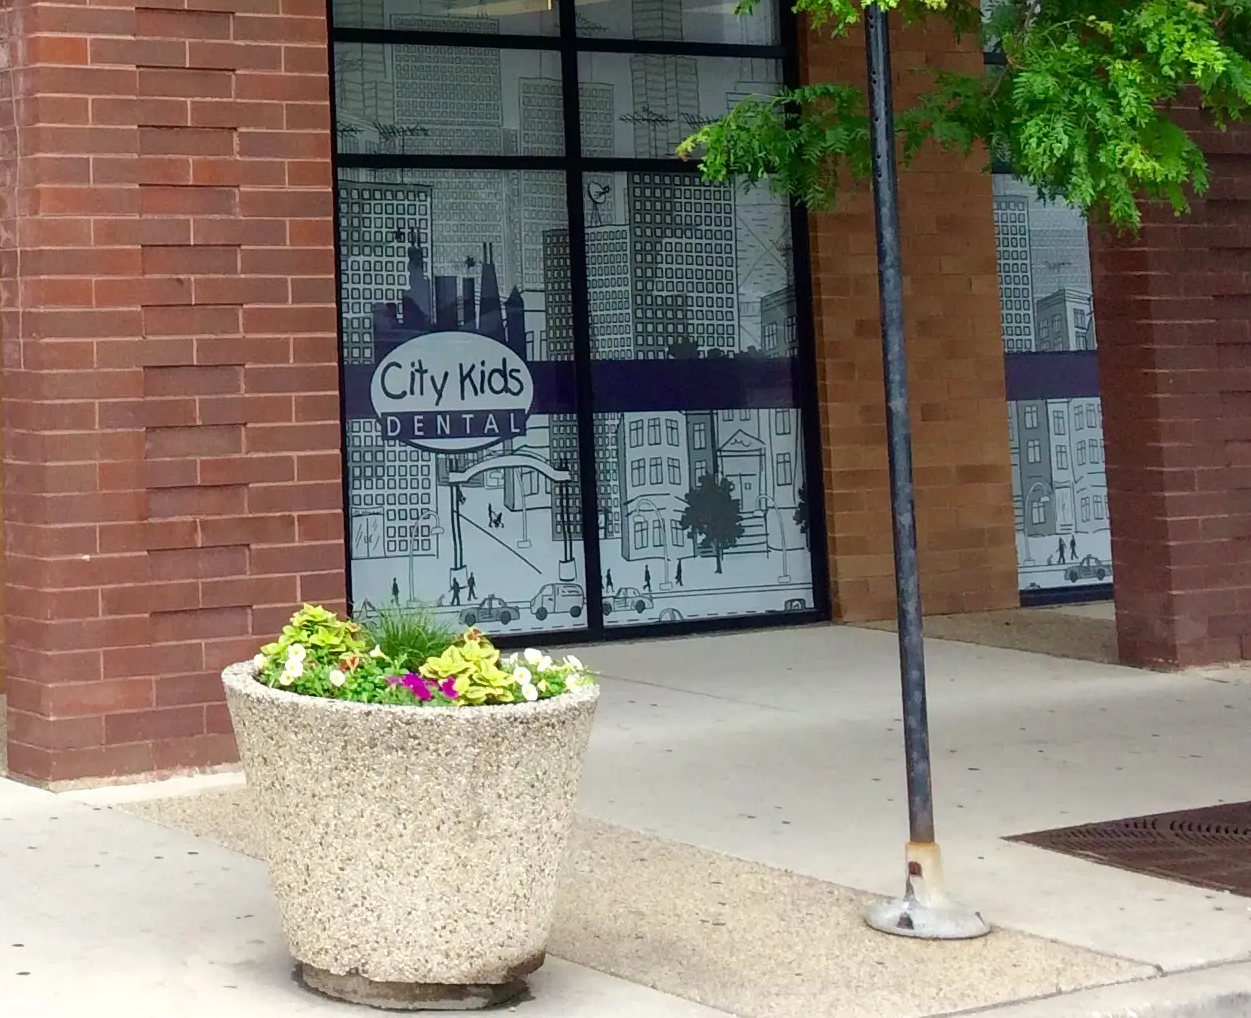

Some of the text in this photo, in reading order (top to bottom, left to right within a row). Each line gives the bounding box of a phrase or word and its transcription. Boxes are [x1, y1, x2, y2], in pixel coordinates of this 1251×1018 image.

[380, 356, 524, 407] City Kids
[386, 412, 521, 437] DENTAL
